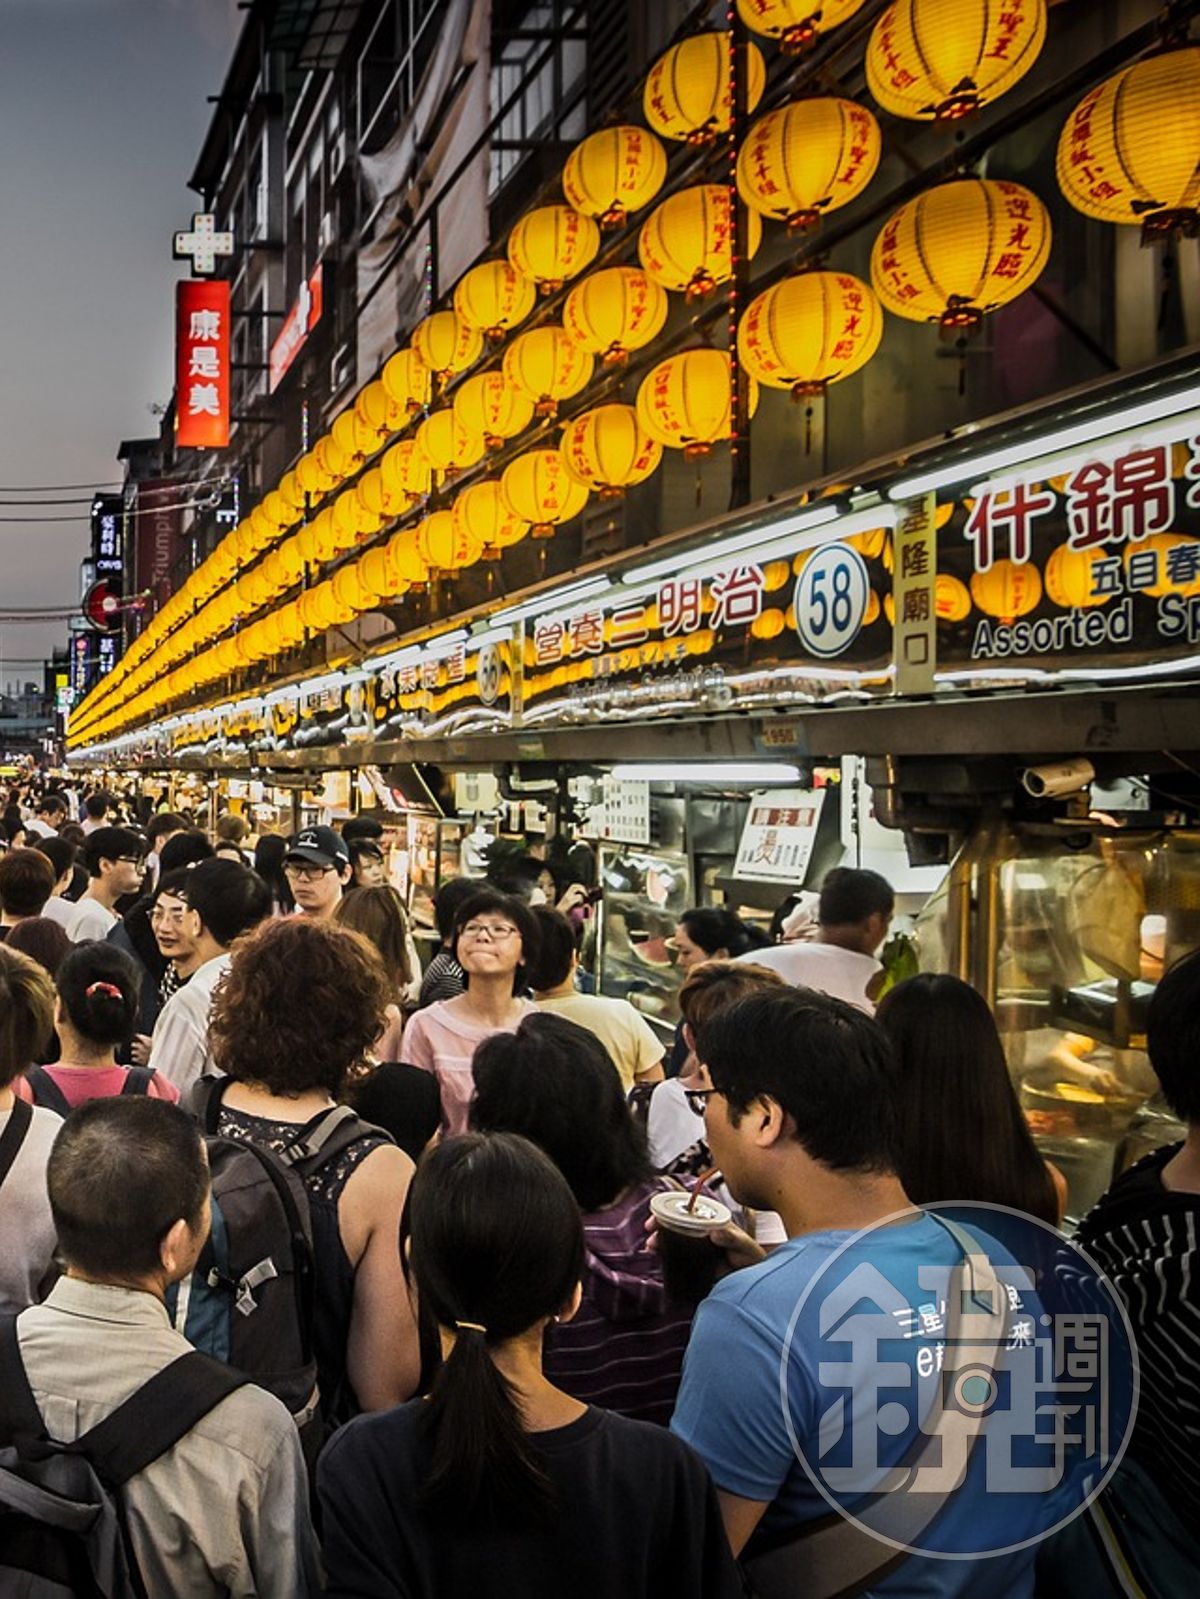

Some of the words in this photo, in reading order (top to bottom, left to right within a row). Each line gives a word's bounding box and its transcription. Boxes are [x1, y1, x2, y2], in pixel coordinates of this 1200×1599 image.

[188, 309, 221, 416] 康是美
[968, 434, 1200, 569] 什錦
[535, 564, 764, 664] 營養三明治
[807, 561, 853, 638] 58
[902, 497, 930, 665] 基隆廟口
[972, 599, 1133, 659] Assorted
